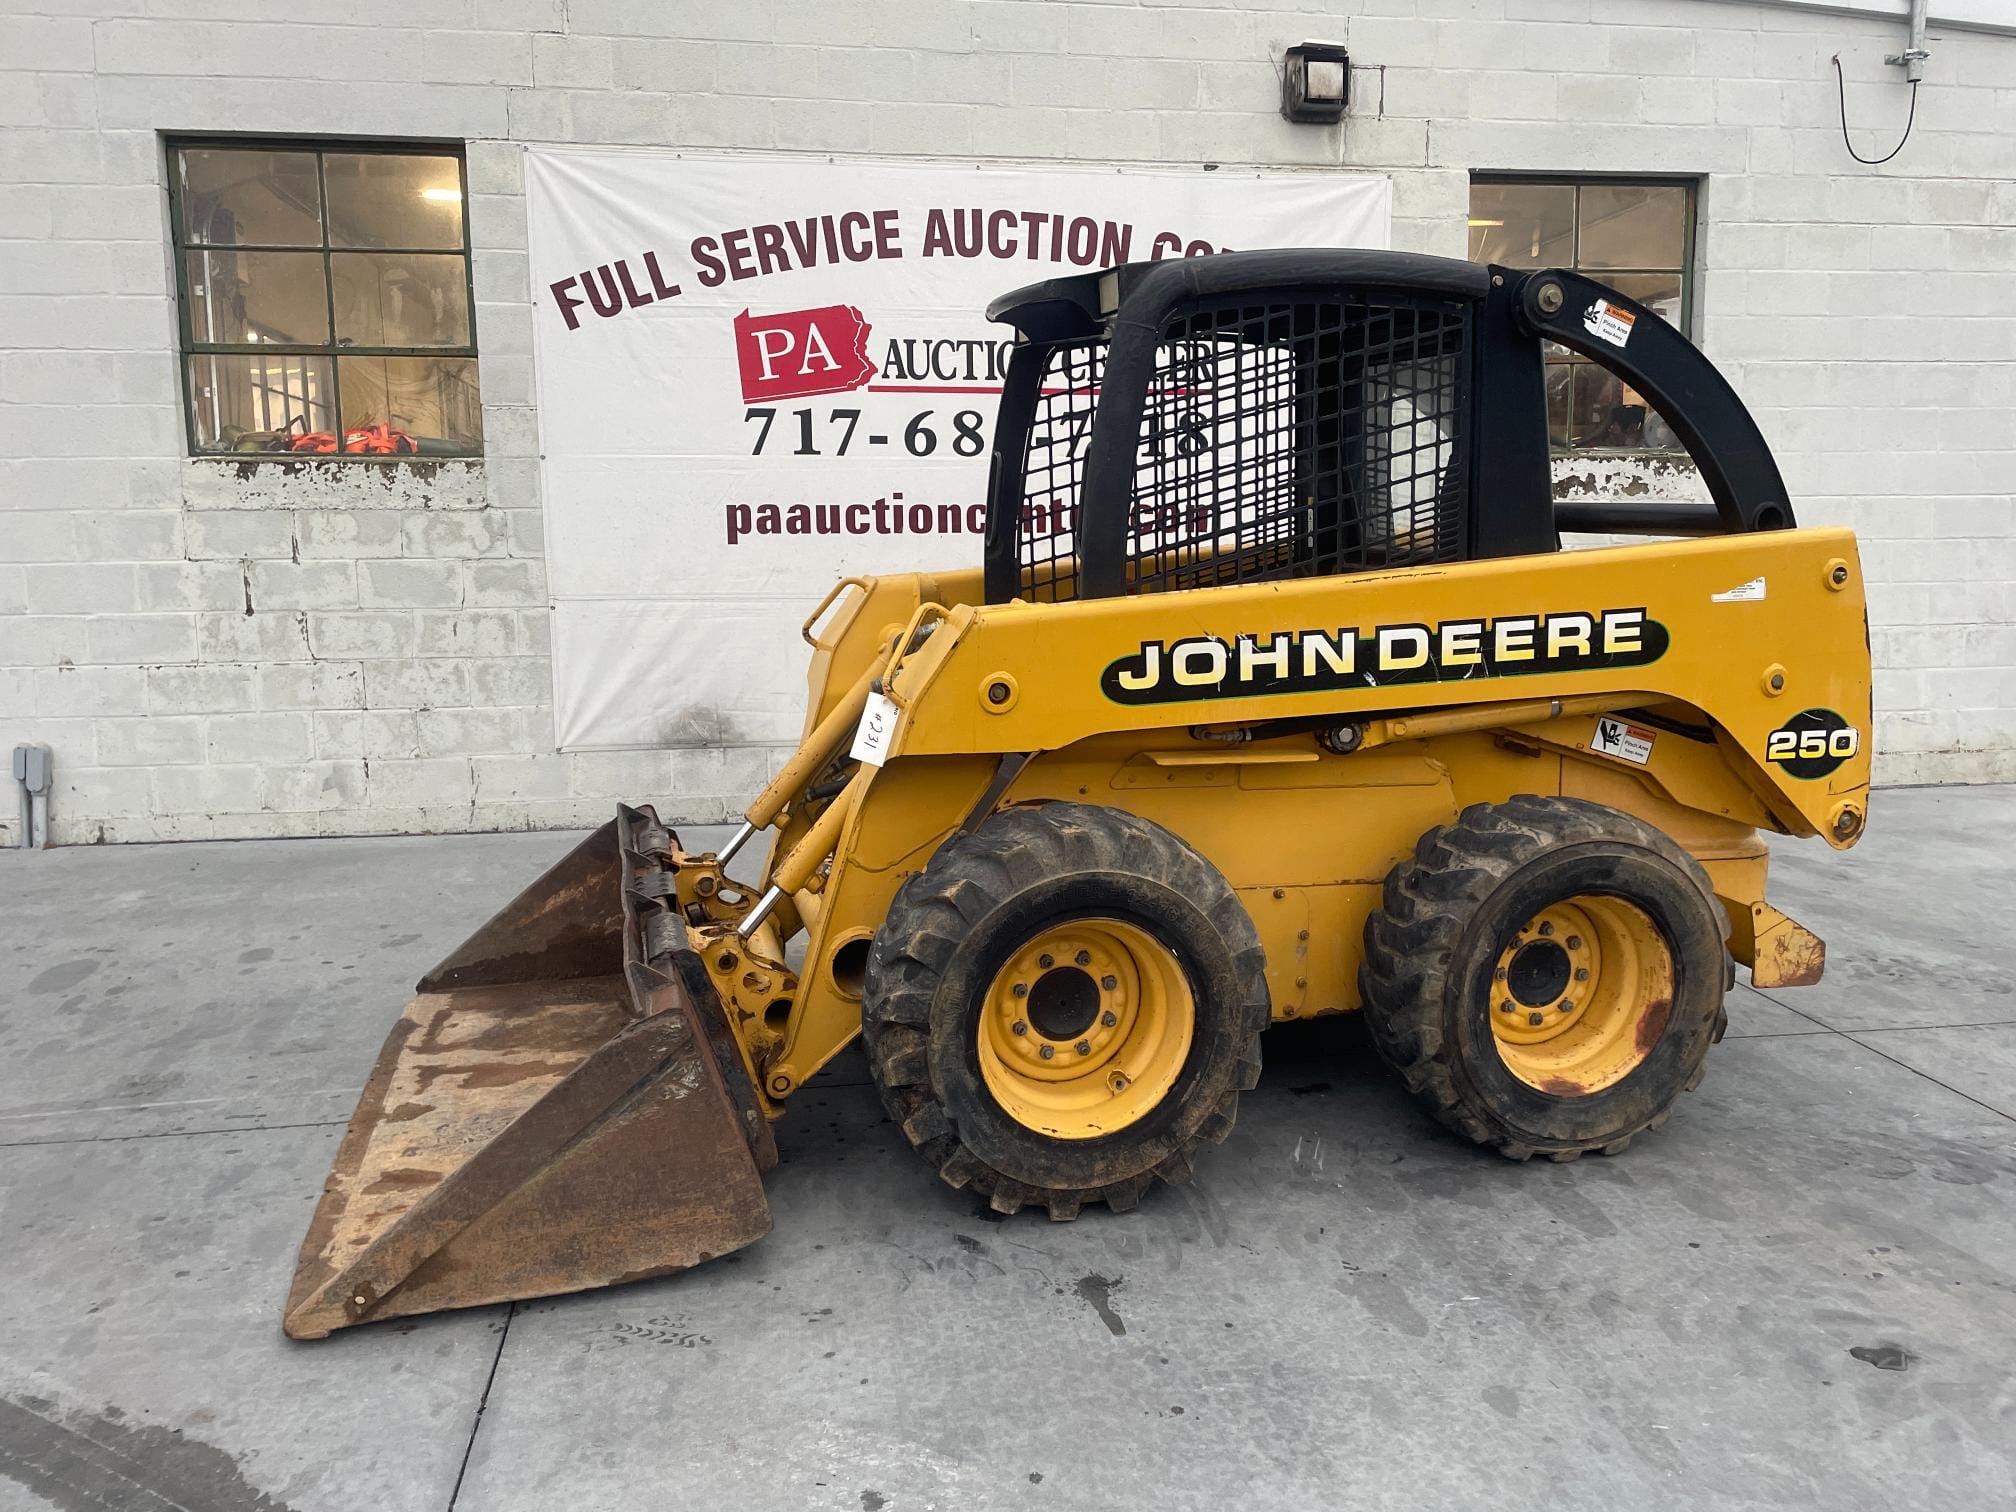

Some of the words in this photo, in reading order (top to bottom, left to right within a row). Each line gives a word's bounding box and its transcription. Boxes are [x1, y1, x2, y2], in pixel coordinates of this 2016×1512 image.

[549, 250, 682, 332] FULL
[690, 209, 903, 288] SERVICE
[922, 208, 1133, 269] AUCTION
[750, 322, 842, 382] PA
[881, 339, 1047, 382] AUCTIO
[744, 407, 1209, 458] 717-68-718
[1118, 632, 1357, 690] JOHN
[1379, 611, 1643, 672] DEERE
[1768, 727, 1859, 760] 250
